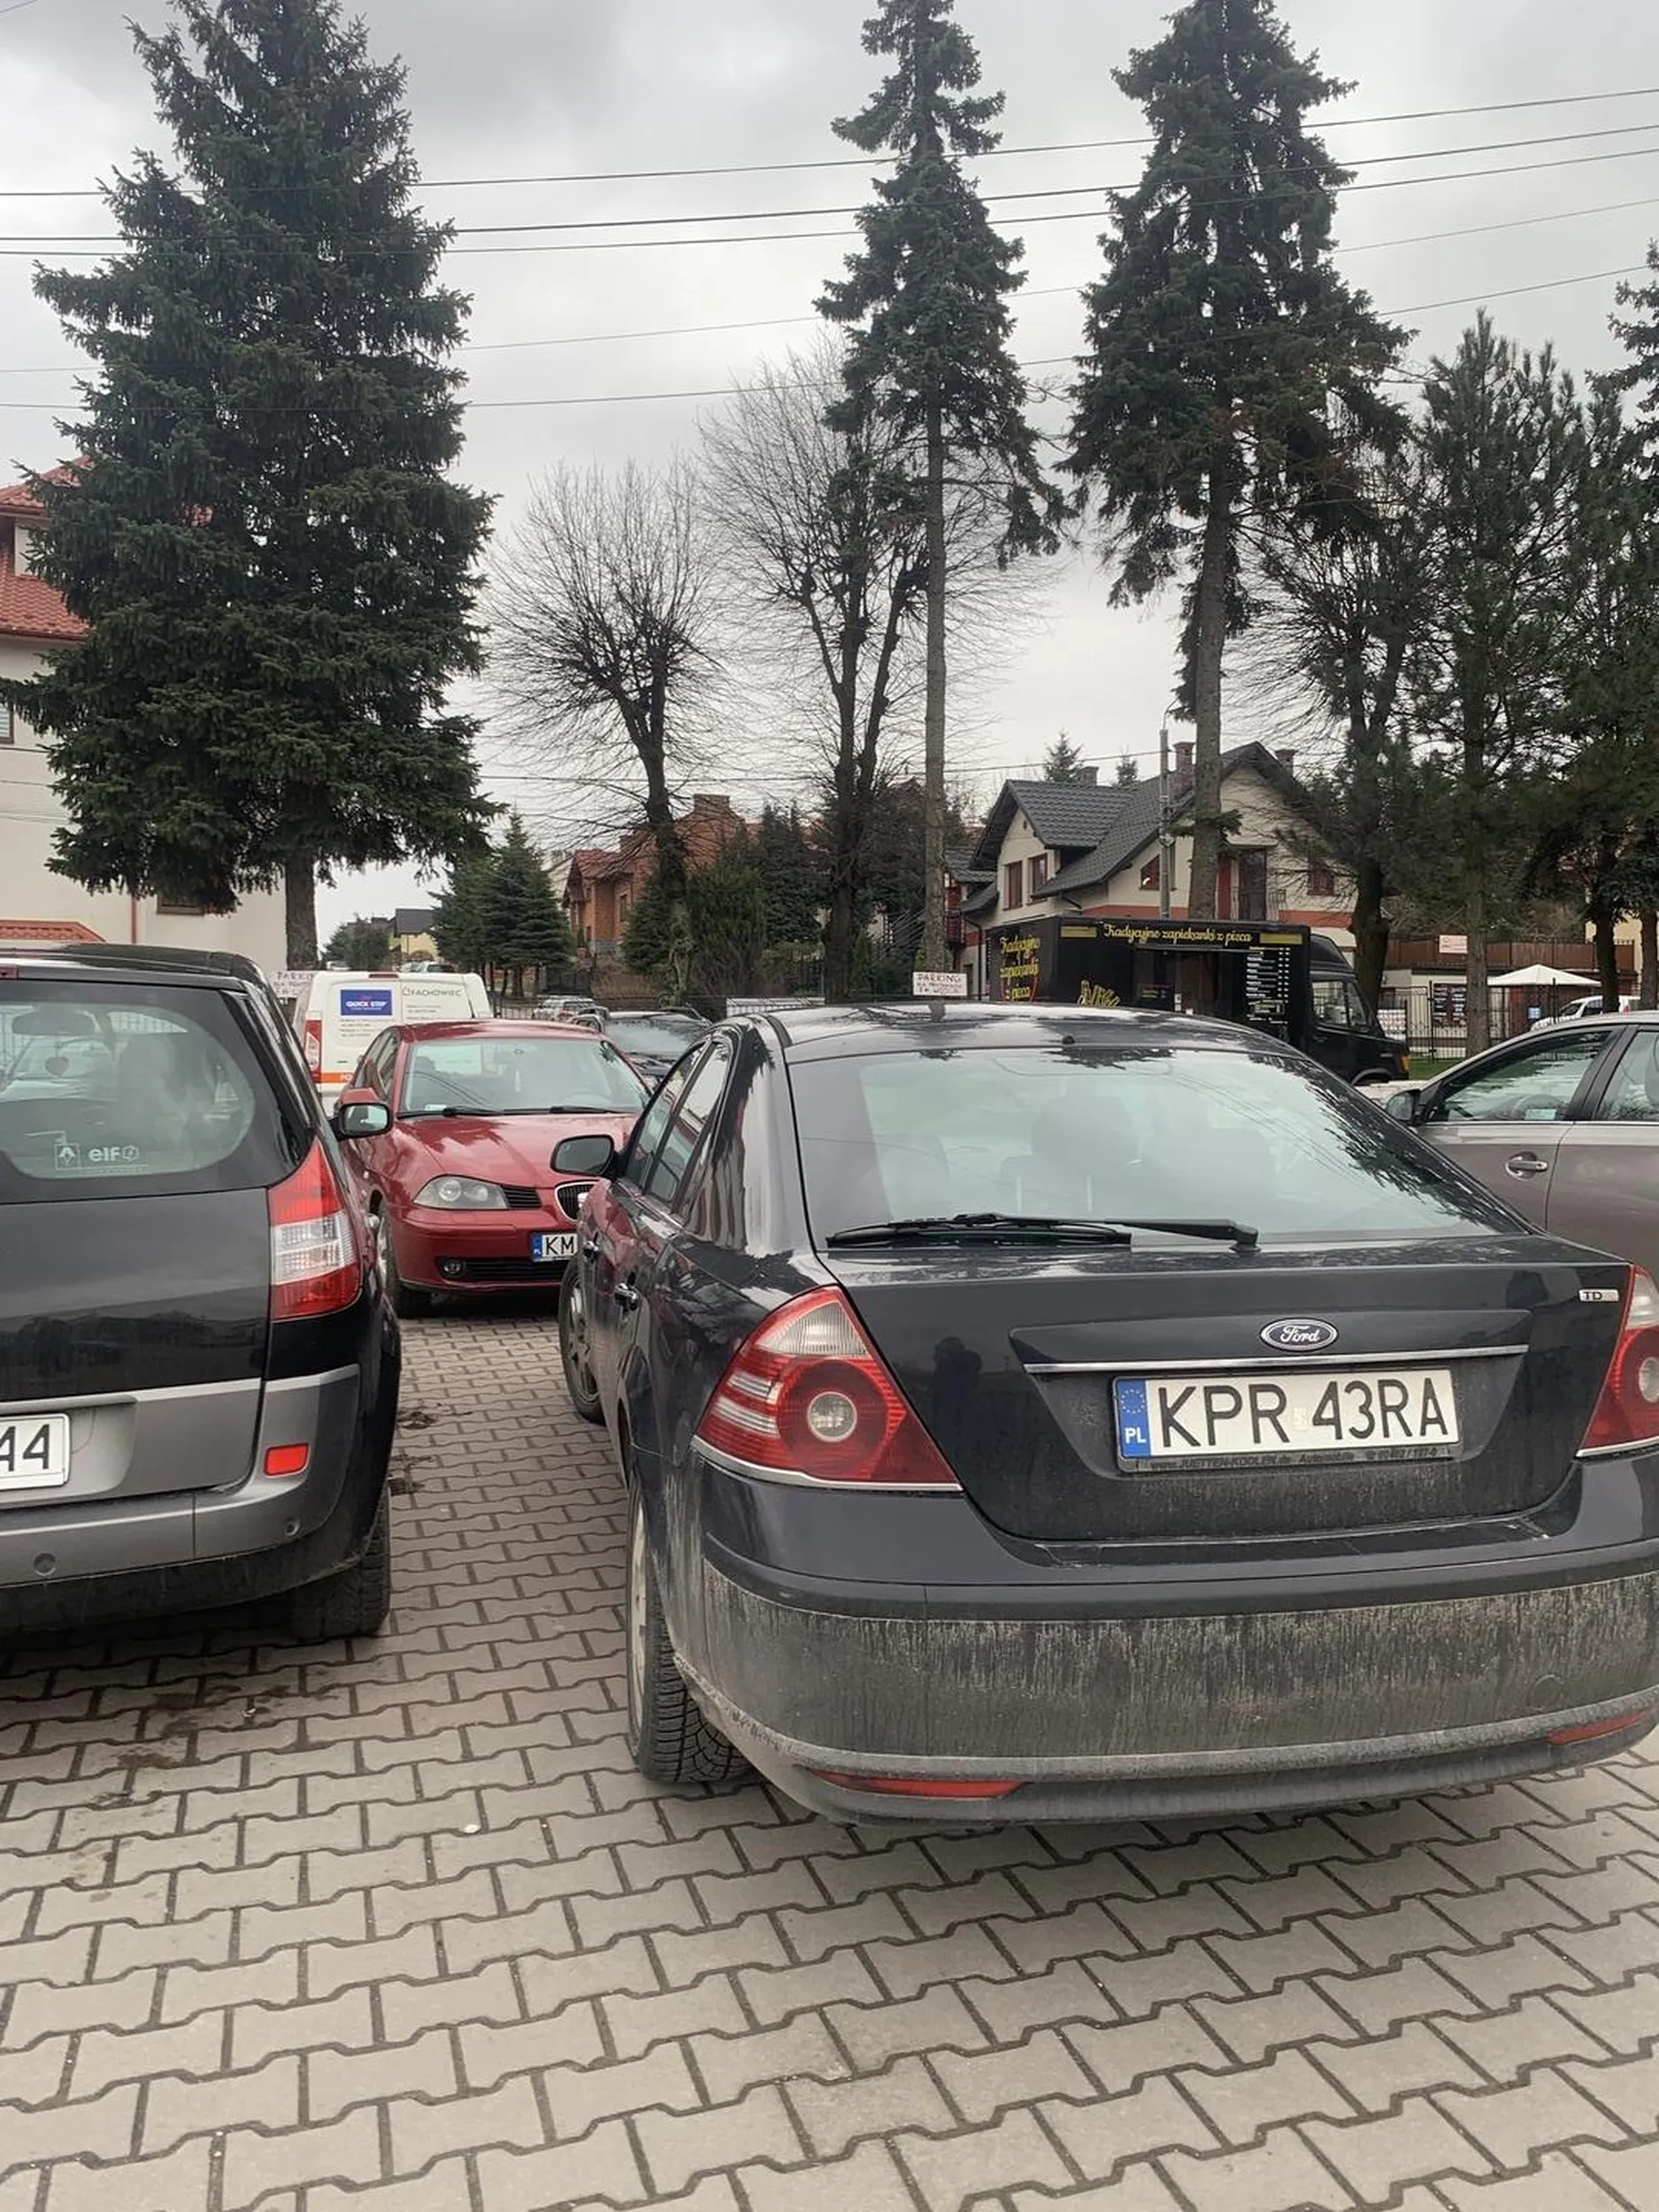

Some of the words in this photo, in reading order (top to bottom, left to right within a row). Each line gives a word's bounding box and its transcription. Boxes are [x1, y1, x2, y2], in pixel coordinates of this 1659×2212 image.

[917, 973, 962, 982] PARKING
[88, 1147, 120, 1162] elf
[546, 1236, 574, 1255] KM
[1280, 1325, 1320, 1342] Ford
[1125, 1426, 1147, 1445] PL
[1157, 1383, 1291, 1448] KPR
[1312, 1377, 1448, 1440] 43RA
[0, 1424, 50, 1472] 44
